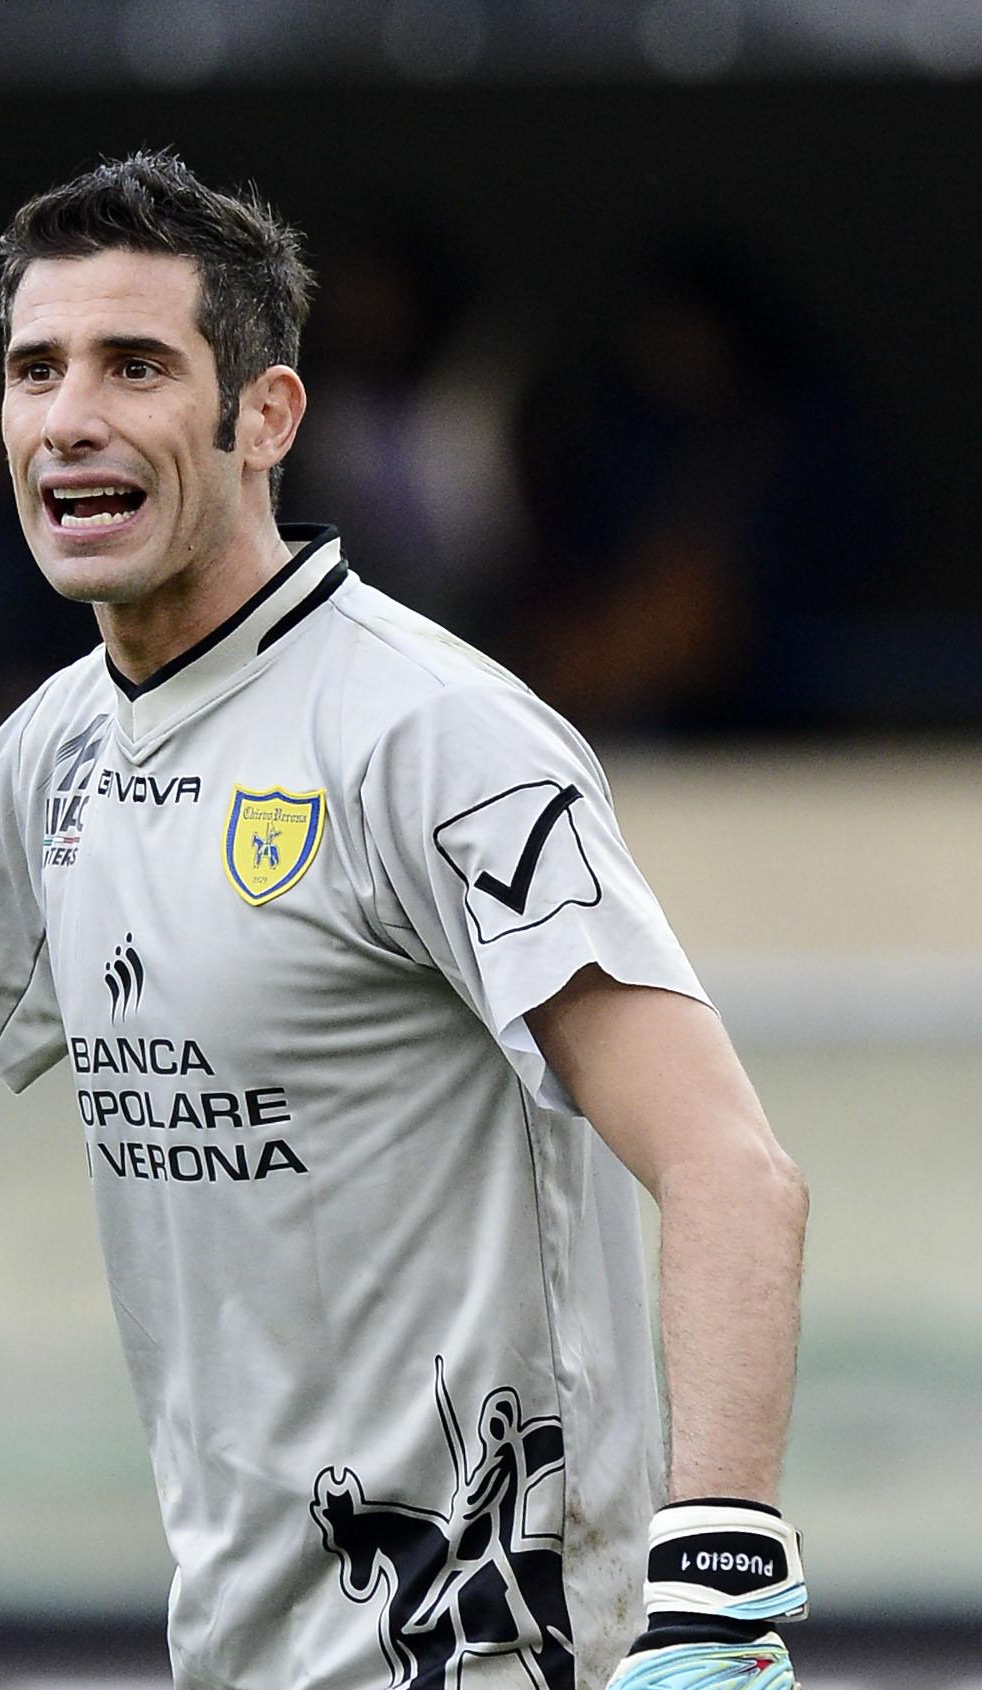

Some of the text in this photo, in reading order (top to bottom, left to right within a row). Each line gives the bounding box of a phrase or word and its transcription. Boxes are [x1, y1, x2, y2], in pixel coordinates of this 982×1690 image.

[97, 769, 201, 806] GIVOVA
[71, 1037, 215, 1076] BANCA
[98, 1139, 309, 1182] VERONA
[696, 1551, 774, 1577] PUGGIO
